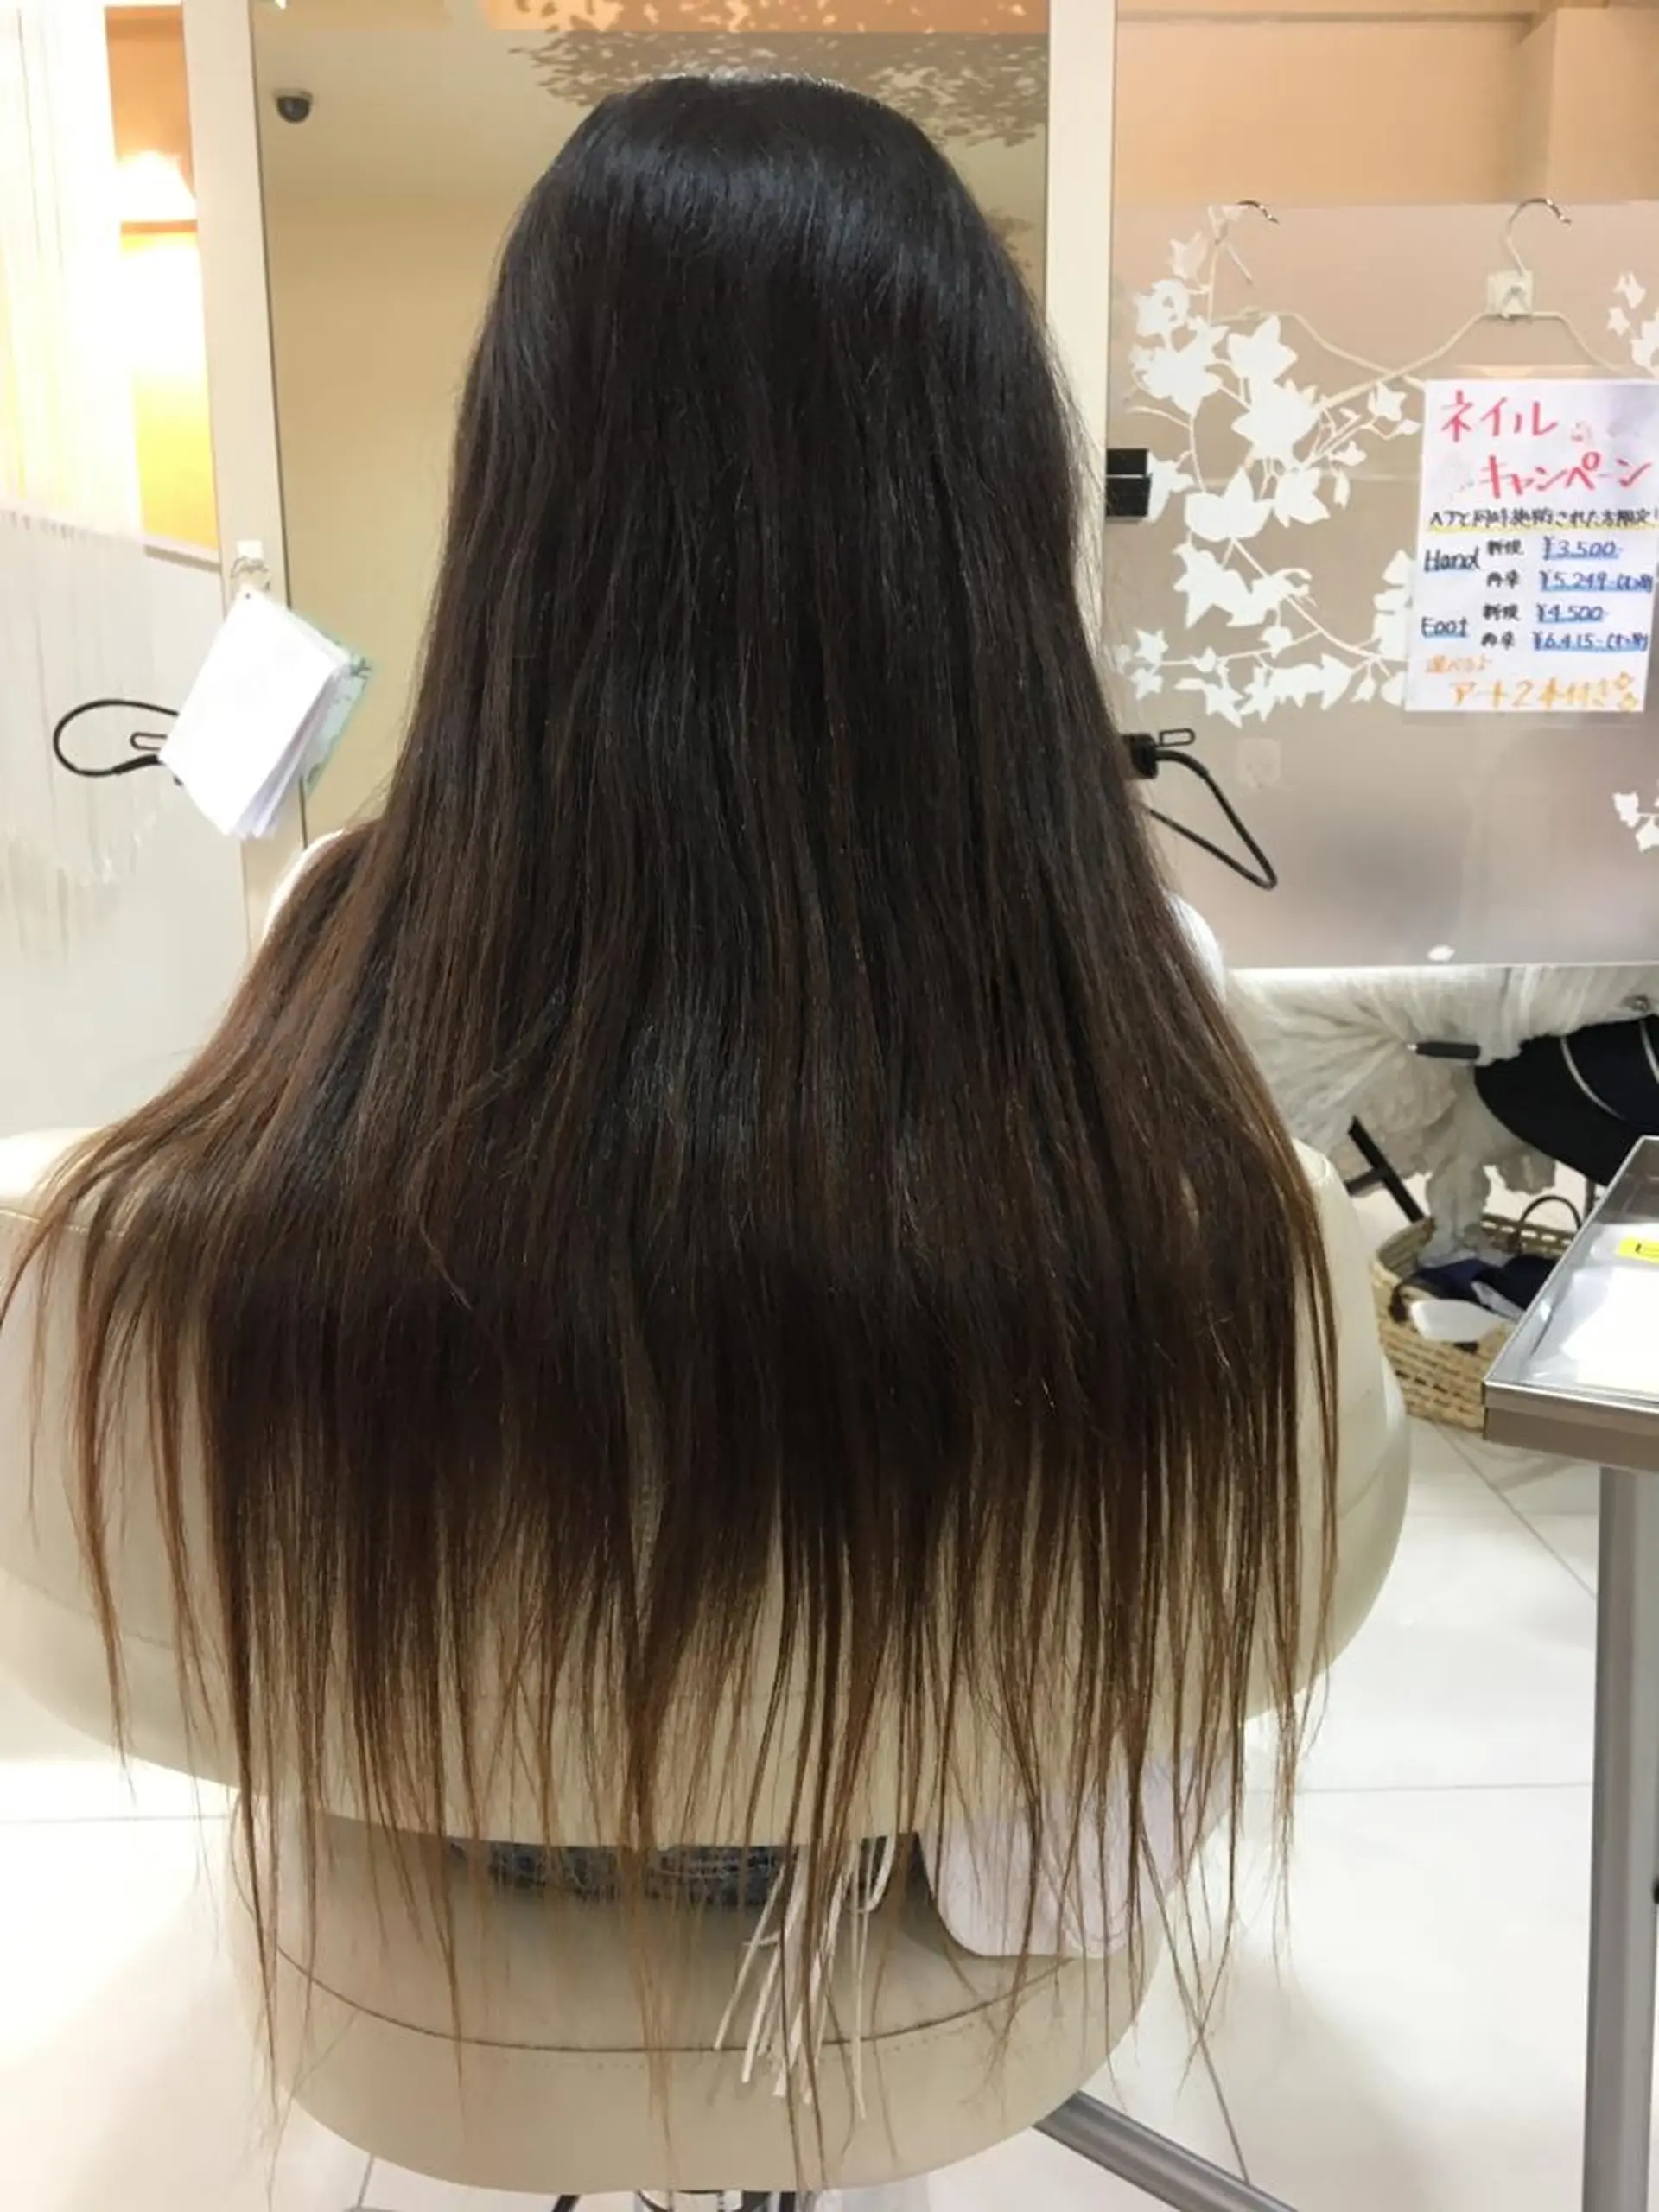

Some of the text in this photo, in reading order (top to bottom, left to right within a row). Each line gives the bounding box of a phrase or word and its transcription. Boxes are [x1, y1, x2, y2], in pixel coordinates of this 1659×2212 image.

[1441, 390, 1559, 442] ネイル
[1479, 451, 1652, 499] キャンペーン
[1424, 545, 1480, 572] Hand
[1421, 616, 1469, 638] Foot
